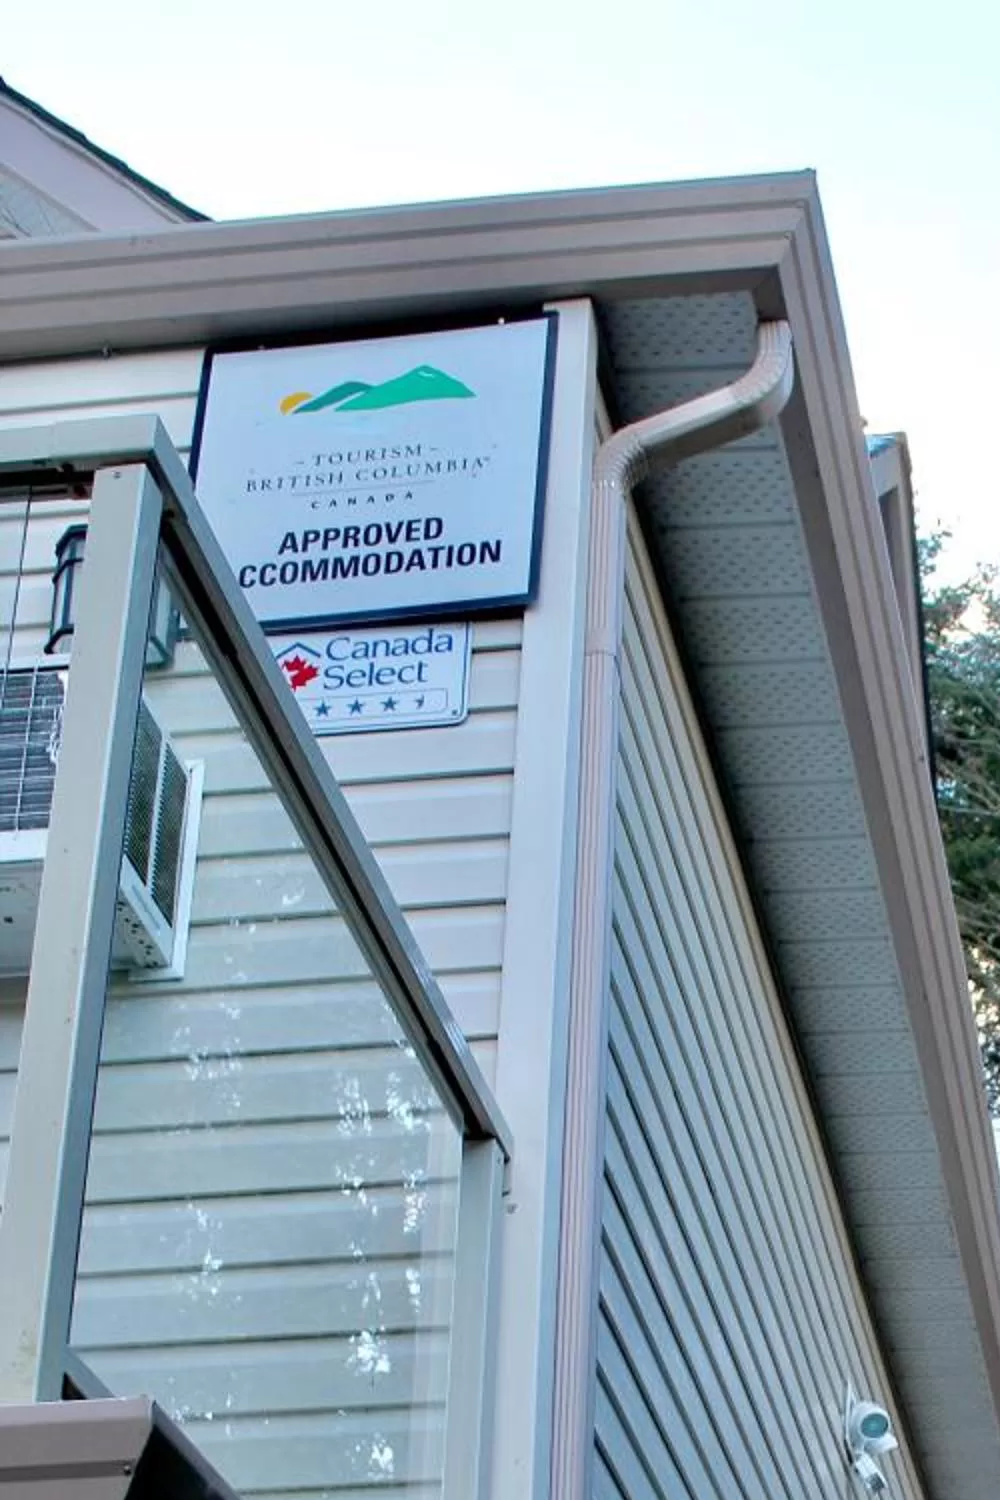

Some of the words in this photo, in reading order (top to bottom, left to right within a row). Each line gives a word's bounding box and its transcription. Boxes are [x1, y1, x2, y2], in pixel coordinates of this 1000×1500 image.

[313, 443, 422, 467] TOURISM
[246, 471, 344, 493] BRITISH
[311, 490, 414, 510] CANADA
[278, 516, 444, 556] APPROVED
[238, 539, 503, 589] CCOMMODATION
[325, 628, 453, 661] Canada
[323, 661, 428, 690] Select
